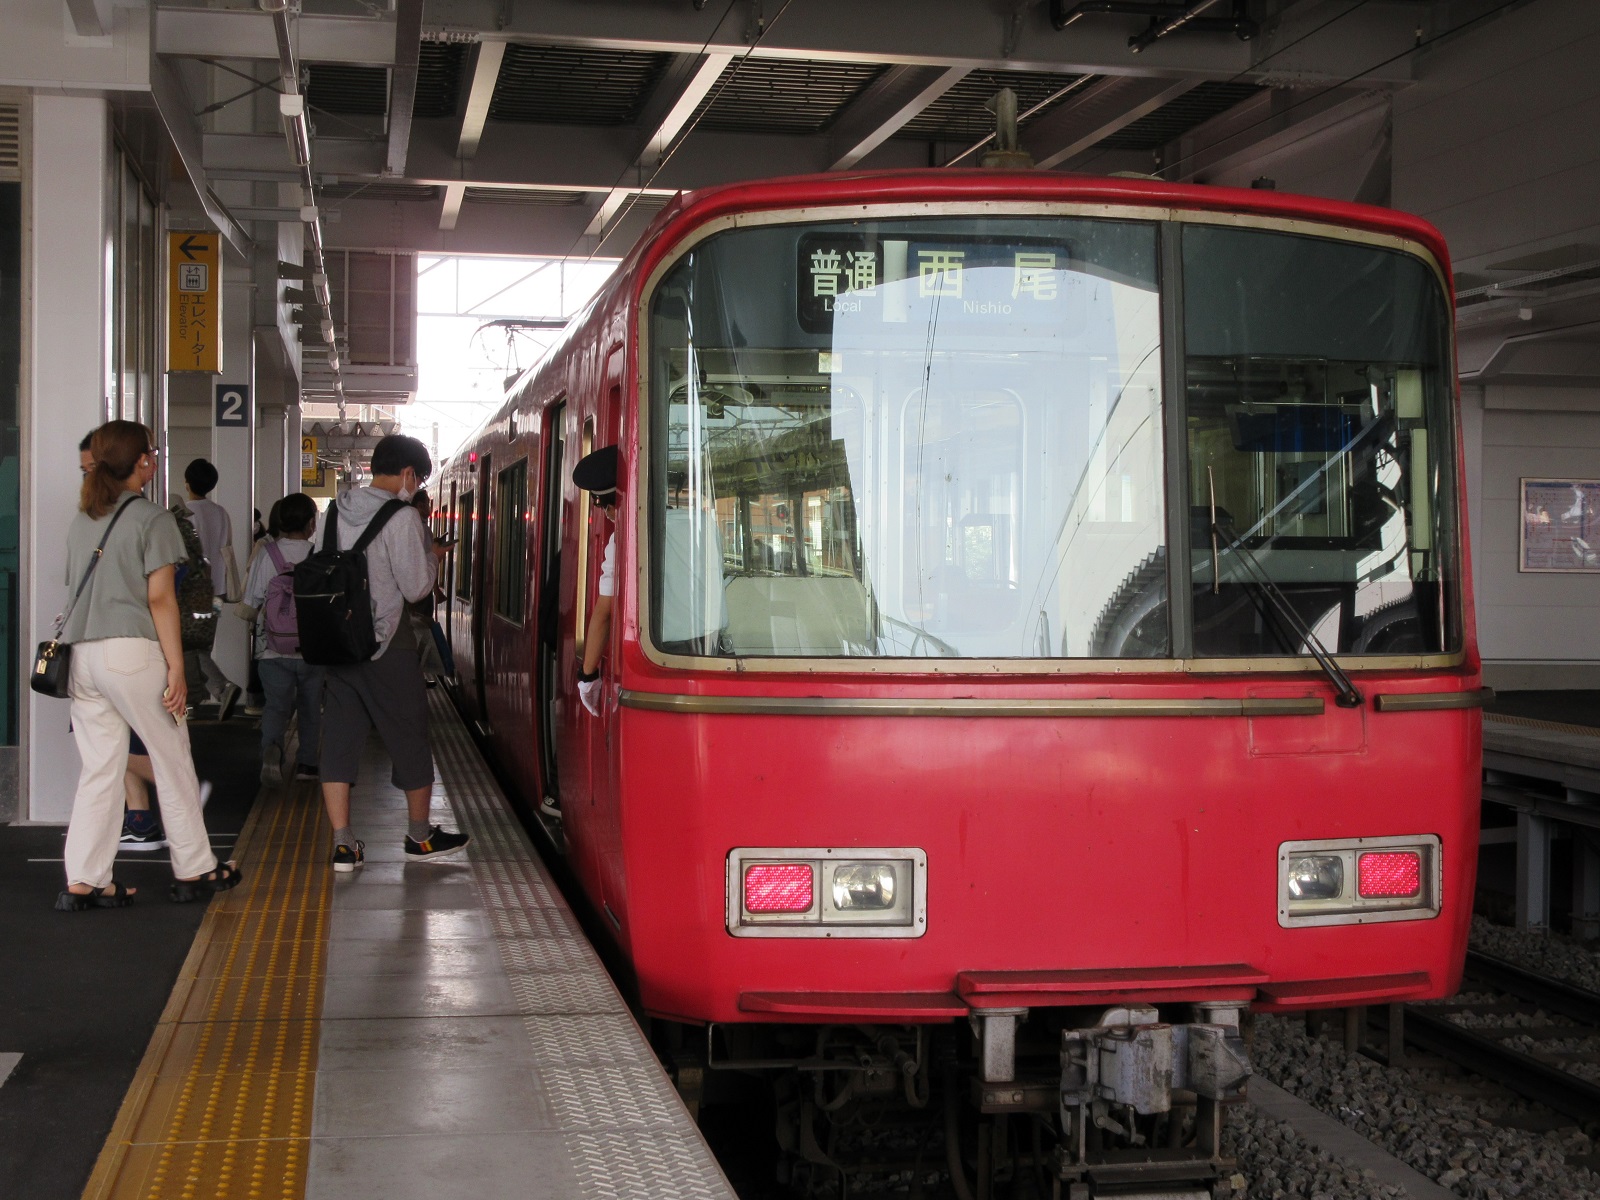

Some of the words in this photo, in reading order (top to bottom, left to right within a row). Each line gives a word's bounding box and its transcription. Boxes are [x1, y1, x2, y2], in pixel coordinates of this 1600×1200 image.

[810, 249, 877, 297] 普通
[918, 250, 1057, 300] 西尾
[179, 294, 189, 339] Elevator
[824, 299, 862, 312] Local
[963, 301, 1012, 314] Nishio
[191, 294, 205, 366] エレベーター
[222, 391, 242, 420] 2
